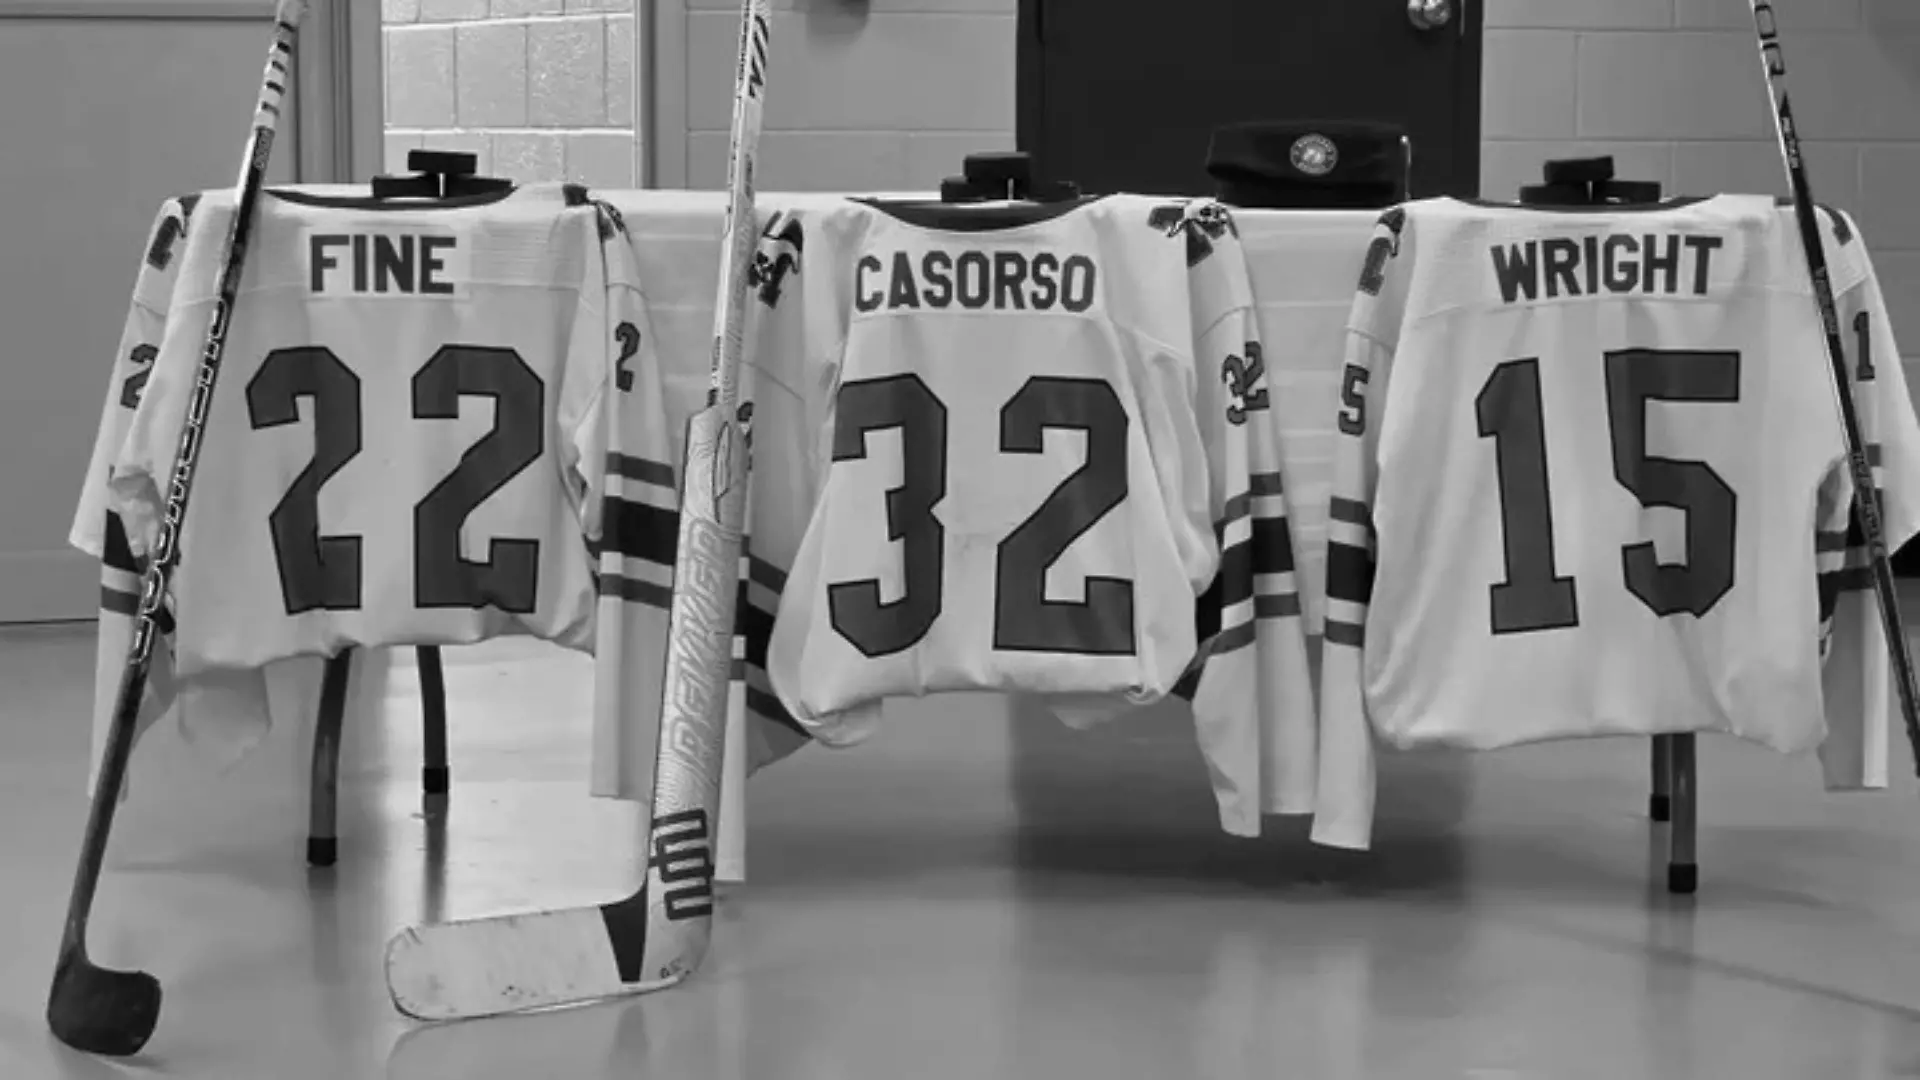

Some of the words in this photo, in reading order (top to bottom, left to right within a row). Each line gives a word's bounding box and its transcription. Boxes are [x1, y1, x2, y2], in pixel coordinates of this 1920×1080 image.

[309, 234, 457, 294] FINE
[854, 250, 1097, 314] CASORSO
[1490, 233, 1723, 303] WRIGHT
[1338, 362, 1371, 437] 5
[244, 344, 545, 614] 22
[827, 372, 1138, 657] 32
[1474, 347, 1740, 635] 15
